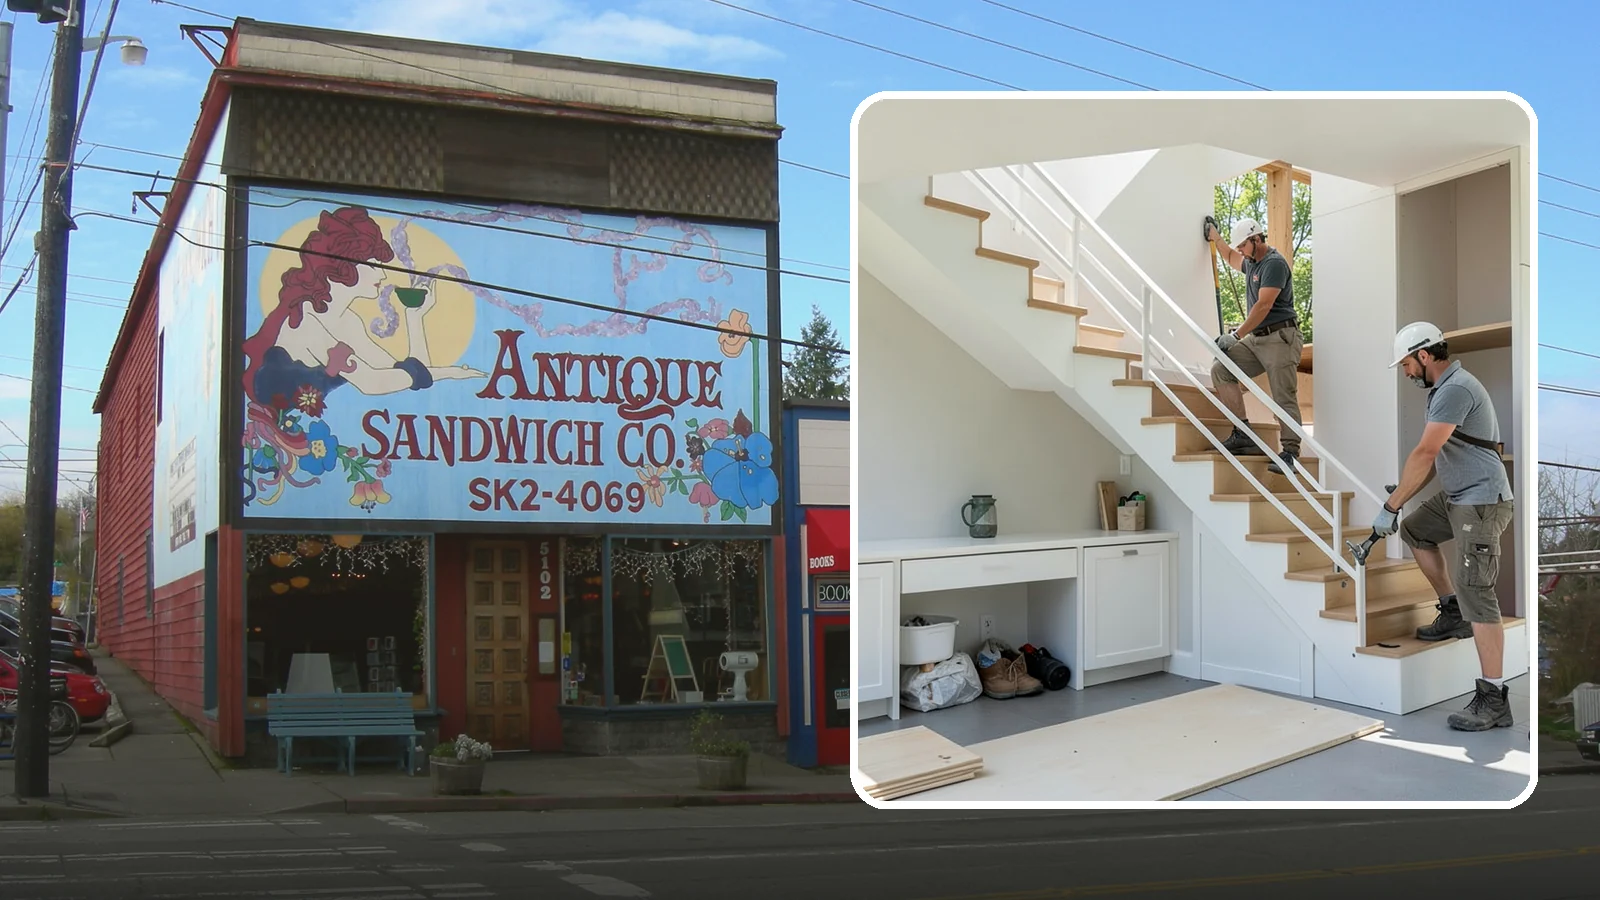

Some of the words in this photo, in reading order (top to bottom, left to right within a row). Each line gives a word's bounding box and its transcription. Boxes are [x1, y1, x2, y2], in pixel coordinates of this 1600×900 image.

[476, 329, 724, 421] ANTIQUE
[360, 407, 605, 468] SANDWICH
[616, 421, 686, 469] CO.
[468, 477, 646, 514] SK2-4069
[540, 541, 552, 600] 5102
[809, 555, 835, 569] BOOKS
